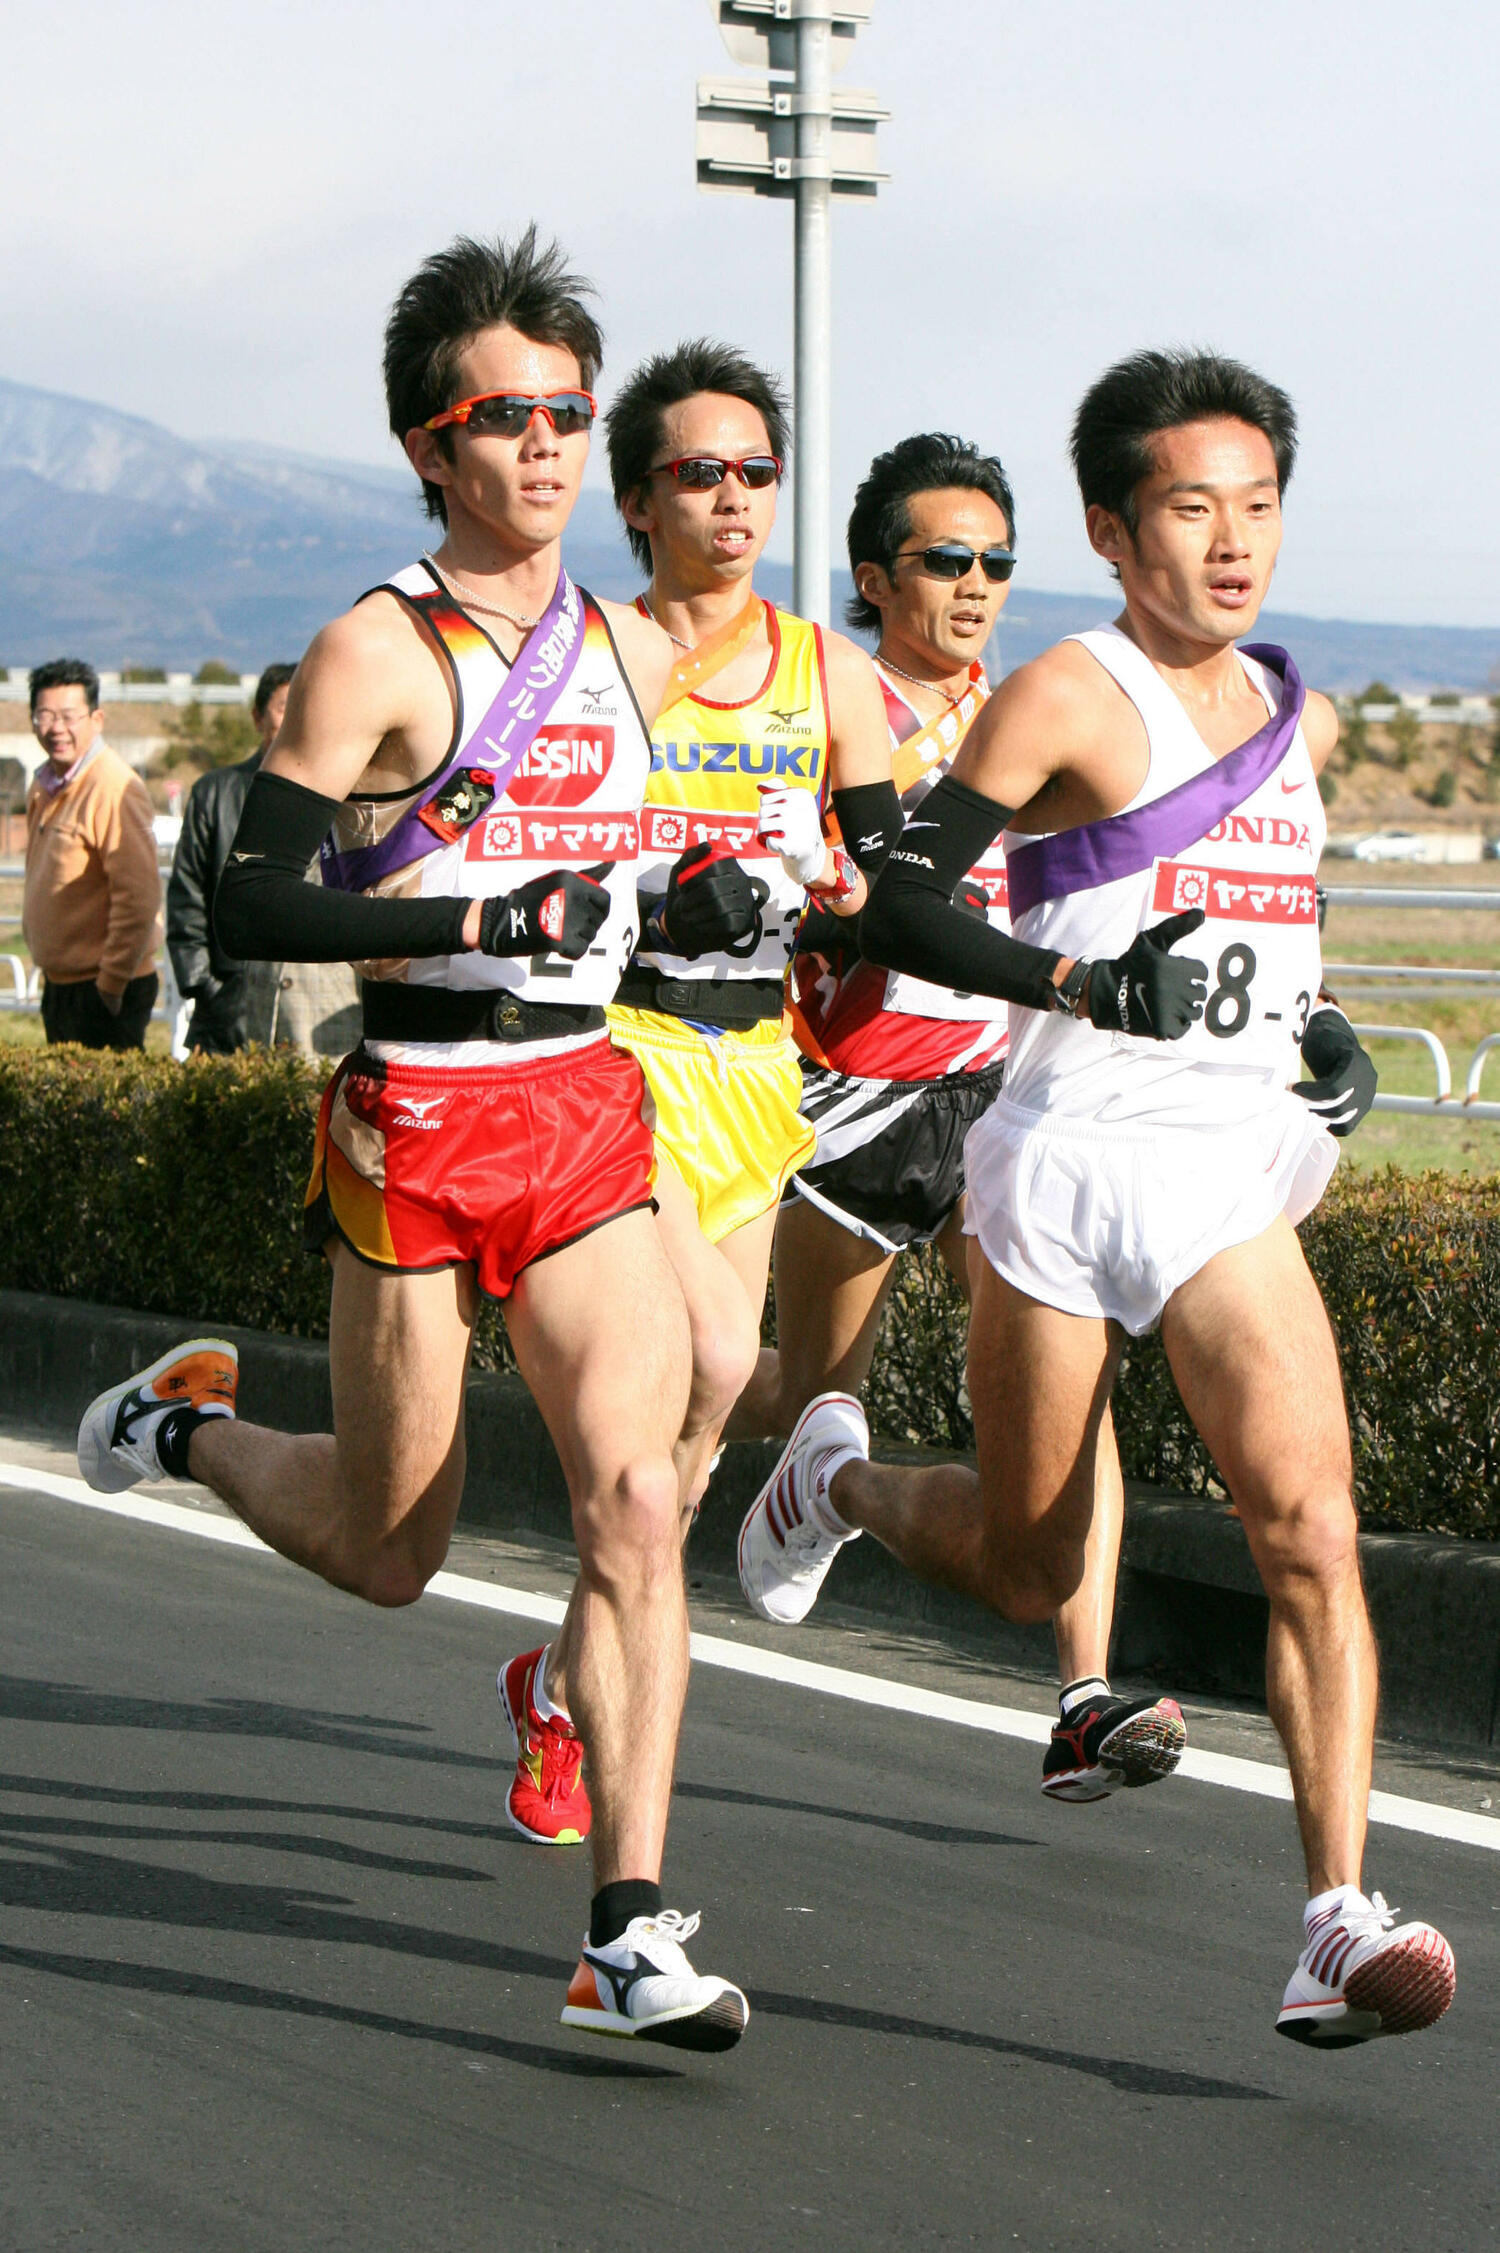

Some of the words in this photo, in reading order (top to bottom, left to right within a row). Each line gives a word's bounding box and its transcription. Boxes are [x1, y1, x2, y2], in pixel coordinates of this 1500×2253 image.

[650, 742, 821, 778] SUZUKI
[693, 823, 755, 850] ヤマ
[1204, 815, 1313, 856] ONDA
[889, 850, 936, 870] ONDA
[1213, 879, 1313, 915] ヤマザキ
[1117, 974, 1131, 1031] HONDA
